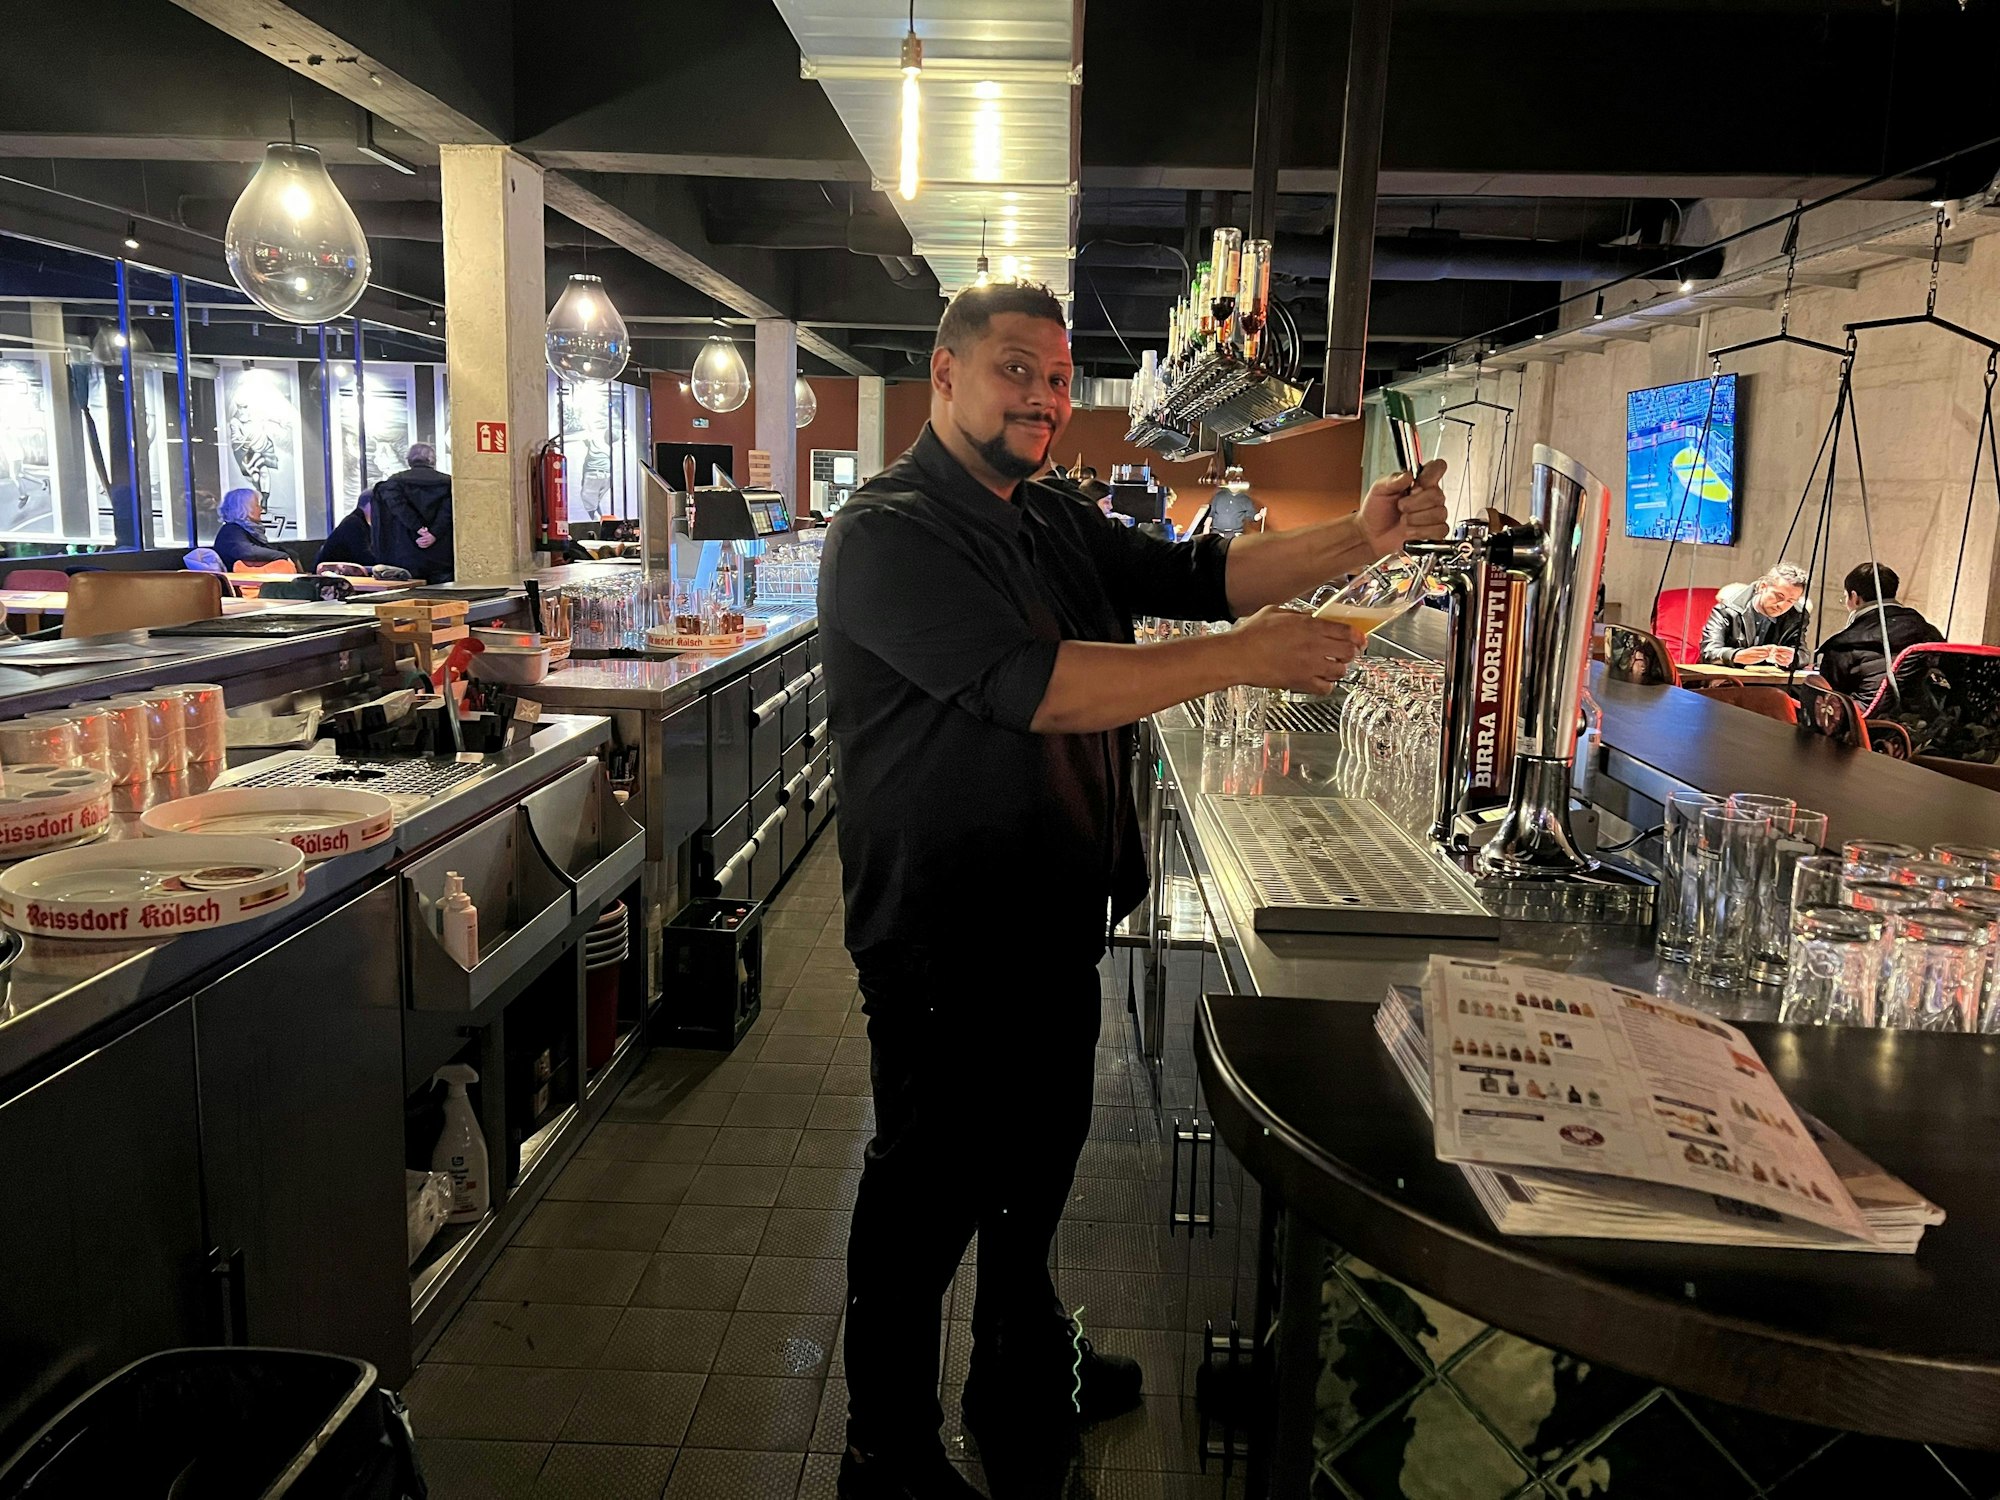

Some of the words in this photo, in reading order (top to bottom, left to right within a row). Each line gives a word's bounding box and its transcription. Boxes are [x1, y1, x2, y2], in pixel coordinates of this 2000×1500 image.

[274, 515, 286, 538] 7
[1480, 590, 1506, 703] MORETTI
[1474, 711, 1497, 789] BIRRA
[291, 828, 348, 855] Kölsch
[26, 903, 130, 931] Reissdorf
[138, 897, 220, 929] Kölsch
